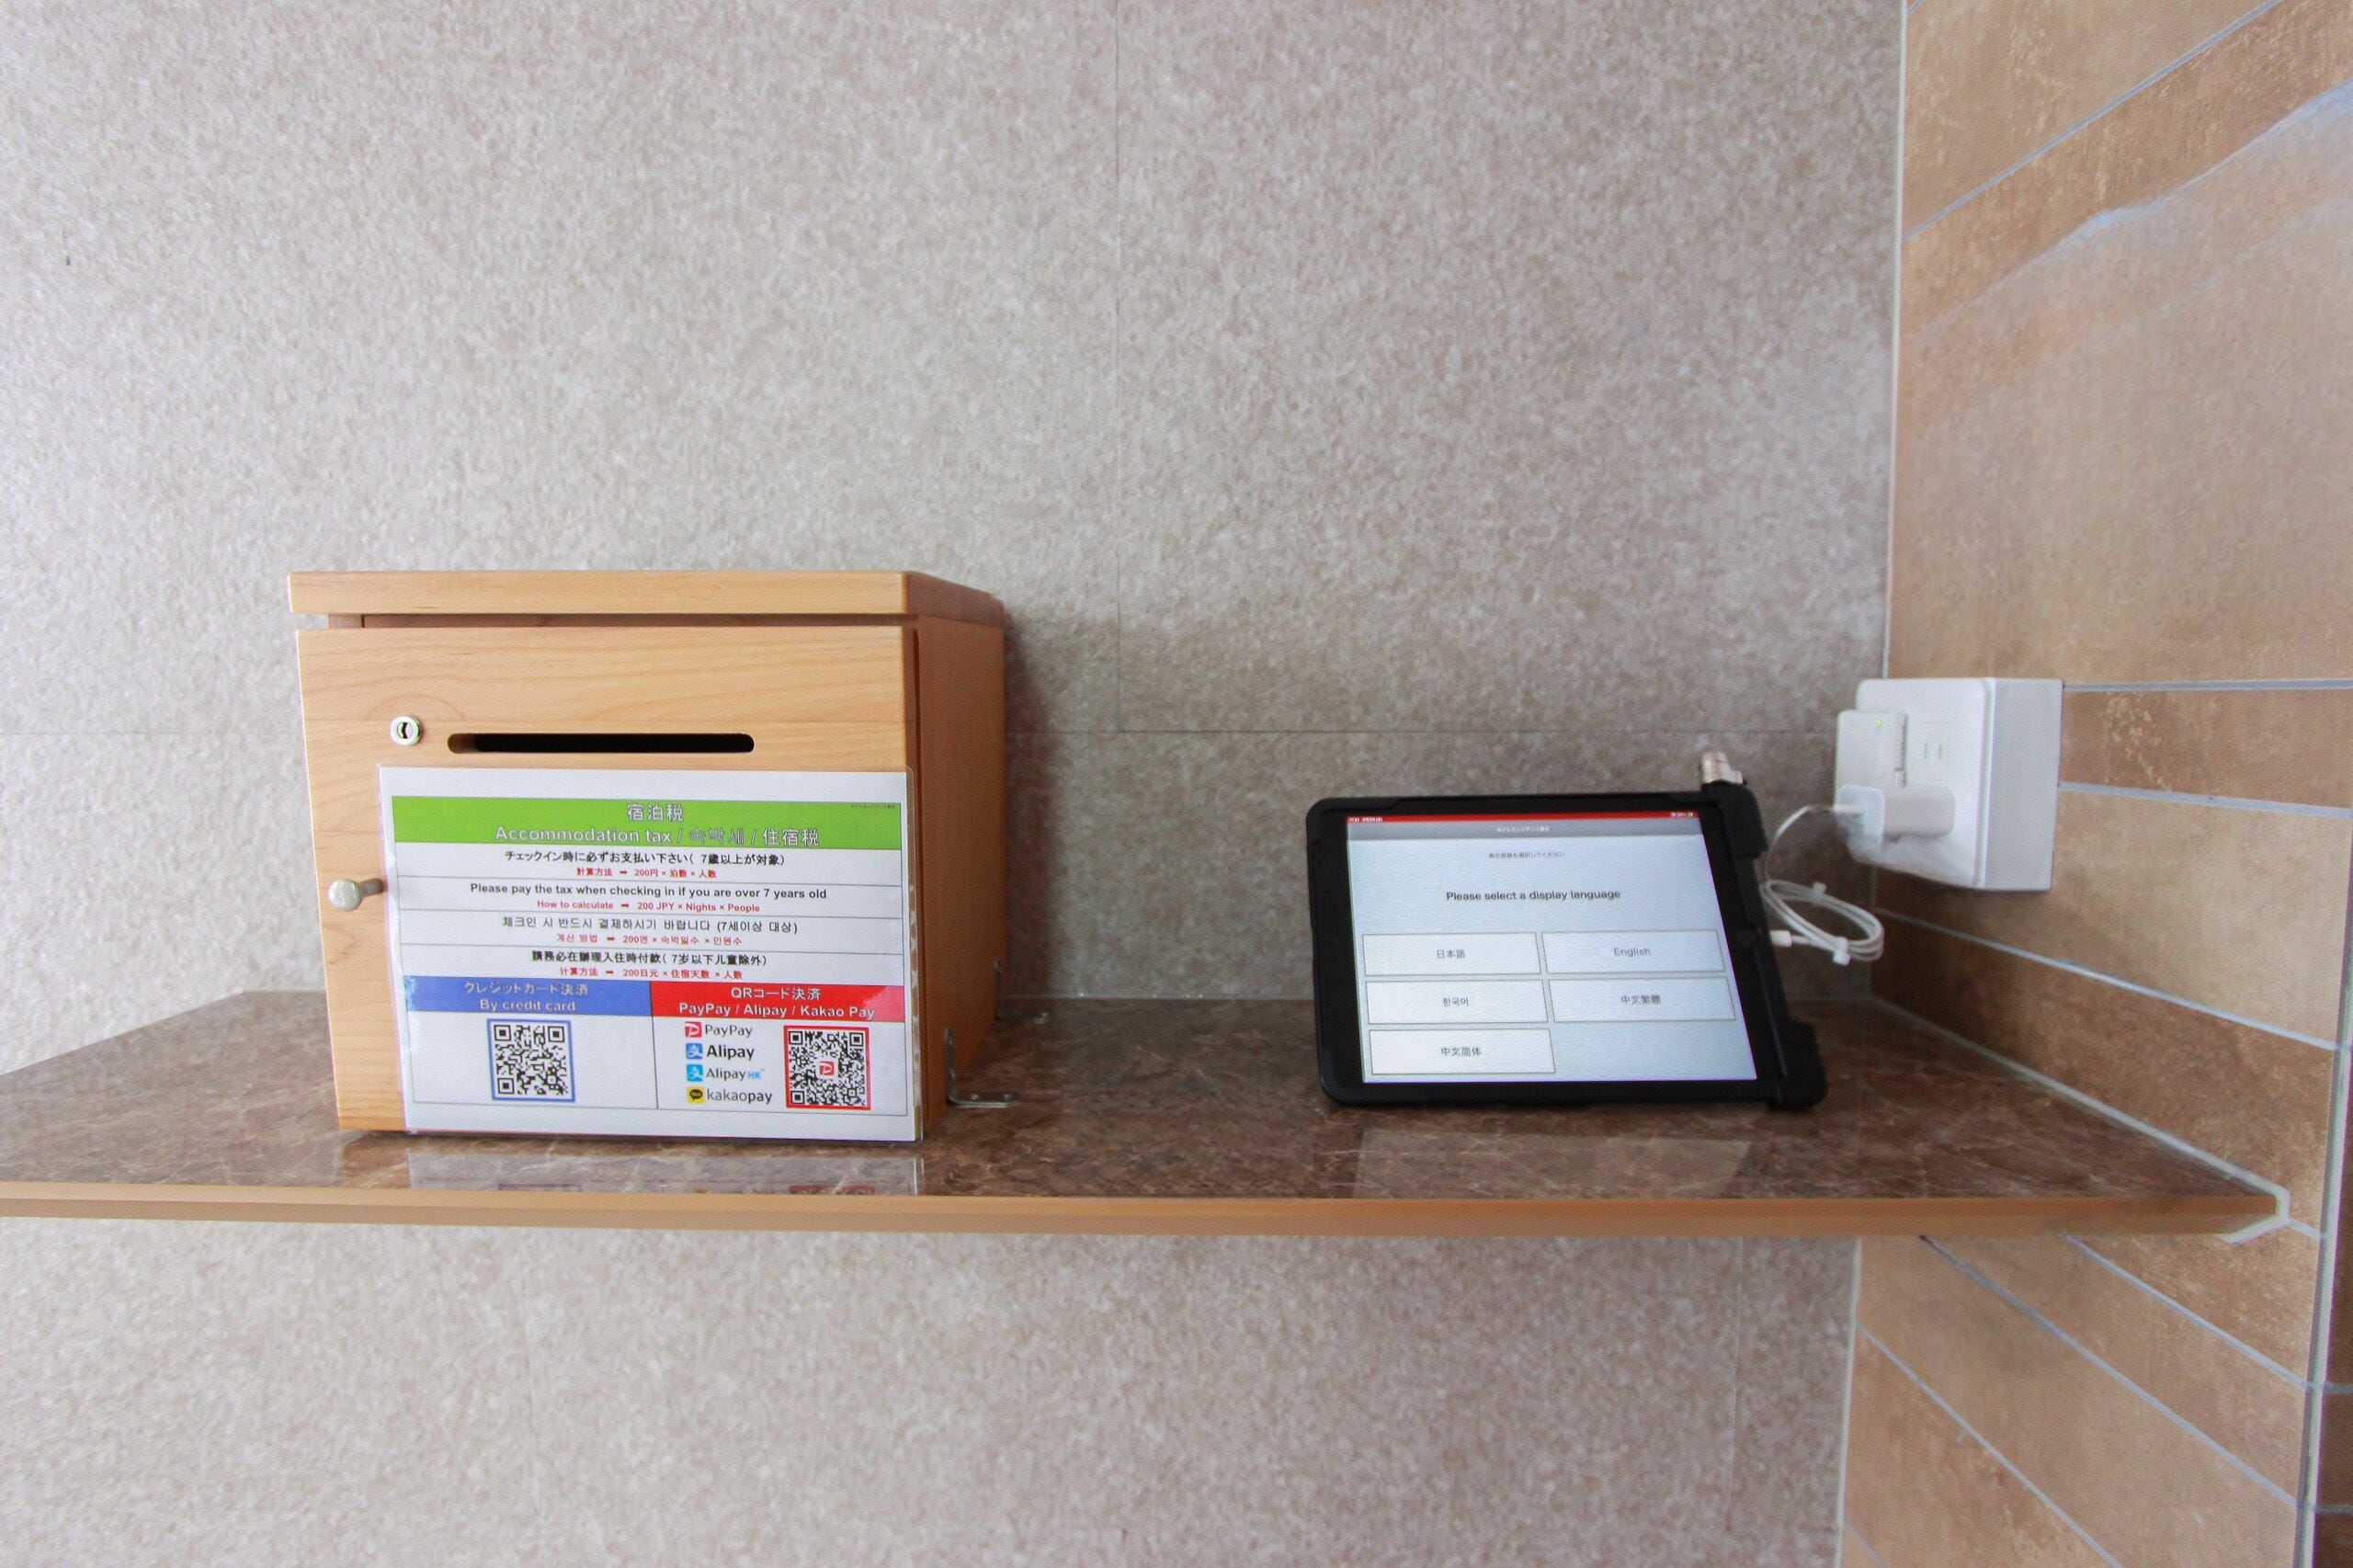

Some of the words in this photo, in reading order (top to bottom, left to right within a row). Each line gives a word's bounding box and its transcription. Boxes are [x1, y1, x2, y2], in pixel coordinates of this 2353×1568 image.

[627, 803, 684, 822] 宿泊税
[495, 826, 640, 843] Accommodation
[645, 828, 672, 843] tax
[690, 827, 745, 845] 숙박세
[634, 869, 659, 878] 200円
[470, 883, 507, 893] Please
[511, 885, 531, 896] pay
[535, 884, 552, 894] the
[555, 885, 573, 894] tax
[576, 885, 607, 895] when
[609, 886, 661, 898] checking
[665, 887, 675, 896] in
[678, 887, 686, 896] if
[689, 889, 710, 899] you
[713, 889, 732, 898] are
[734, 889, 761, 898] over
[763, 888, 770, 898] 7
[773, 890, 805, 900] years
[808, 889, 827, 899] old
[1446, 892, 1482, 901] Please
[1484, 891, 1517, 901] select
[1529, 890, 1568, 902] display
[1571, 889, 1621, 901] language
[537, 900, 558, 908] How
[560, 900, 570, 909] to
[572, 901, 614, 910] calculate
[637, 902, 654, 910] 200
[656, 902, 675, 911] JPY
[686, 903, 717, 913] Nights
[727, 903, 760, 914] People
[502, 916, 537, 927] 체크인
[542, 916, 553, 928] 시
[558, 917, 593, 929] 반드시
[598, 918, 657, 930] 결제하시기
[664, 919, 710, 931] 바랍니다
[1437, 949, 1466, 960] 日本語
[1613, 947, 1652, 958] English
[464, 981, 589, 995] クレジットカード決済
[731, 986, 821, 1001] QRコード決済
[480, 999, 498, 1012] By
[502, 999, 541, 1011] credit
[545, 1000, 576, 1011] card
[1442, 996, 1470, 1007] 한국어
[678, 1003, 732, 1017] PayPay
[744, 1004, 788, 1018] Alipay
[800, 1005, 845, 1017] Kakao
[848, 1006, 876, 1021] Pay
[705, 1024, 753, 1037] PayPay
[707, 1044, 755, 1060] Alipay
[707, 1087, 773, 1104] kakaopay
